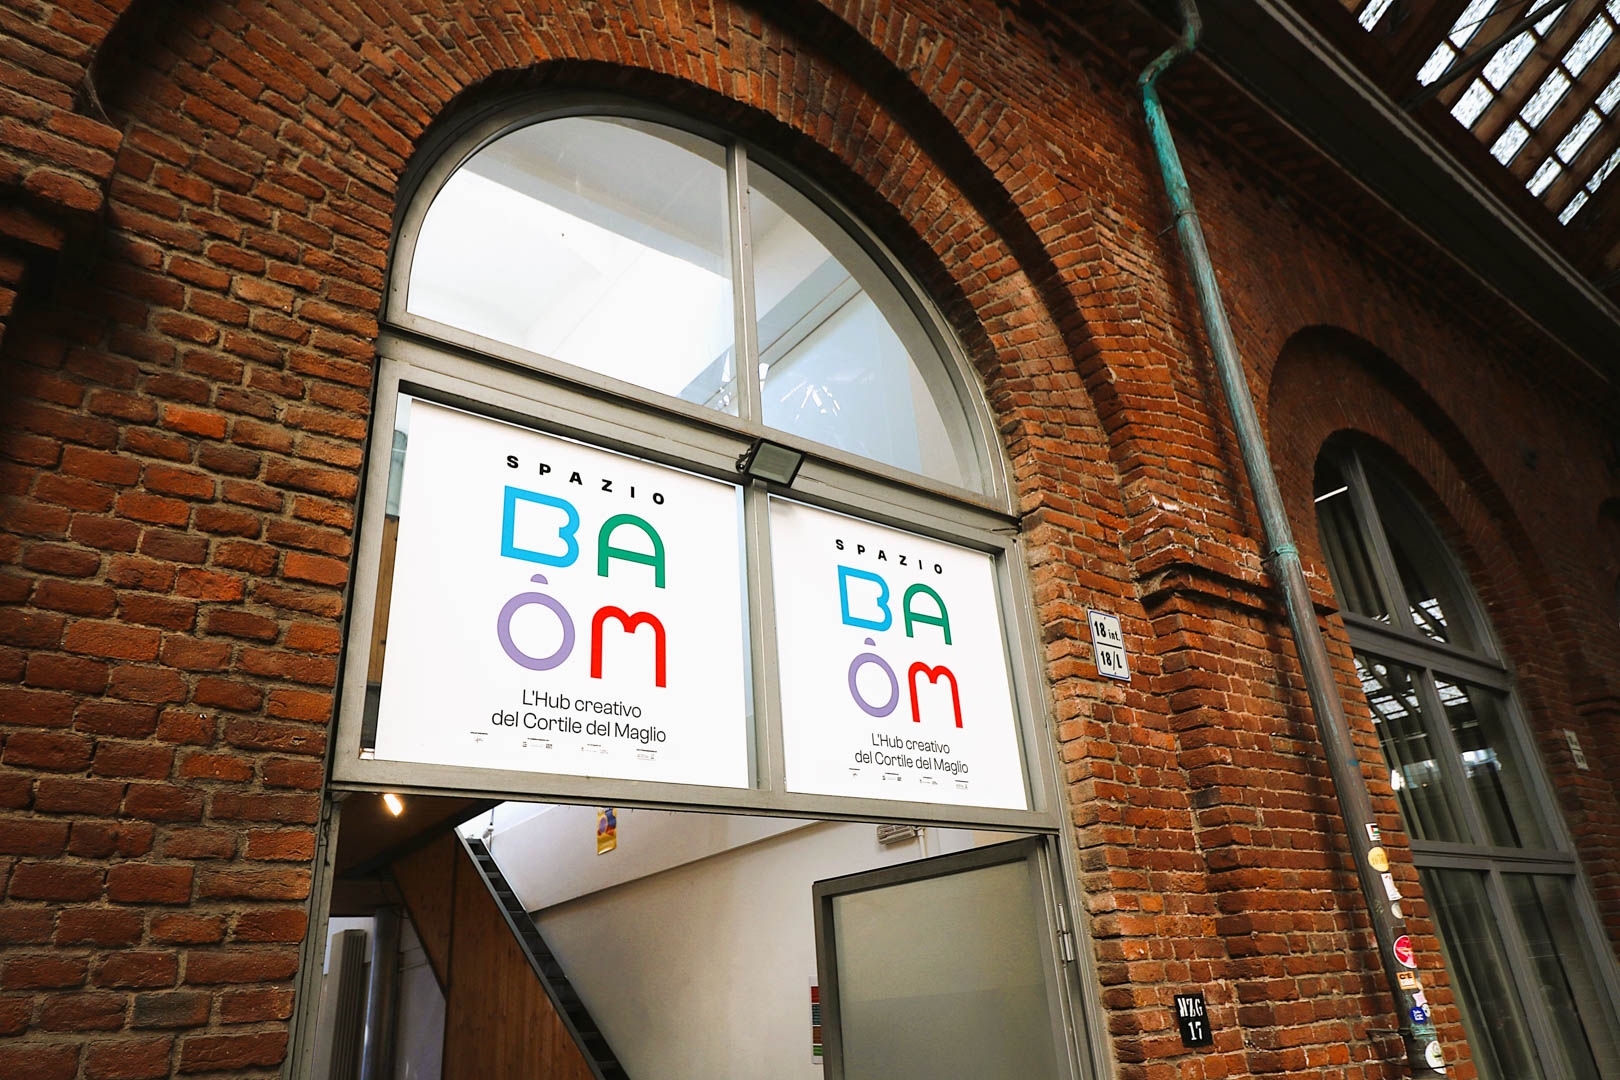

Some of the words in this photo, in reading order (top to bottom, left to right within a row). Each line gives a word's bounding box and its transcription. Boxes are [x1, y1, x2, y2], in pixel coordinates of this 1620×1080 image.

[506, 455, 665, 506] SPAZIO
[835, 538, 944, 575] SPAZIO
[1094, 620, 1107, 639] 18
[1108, 629, 1121, 642] int.
[1100, 650, 1123, 671] 18/L
[522, 688, 571, 710] L'Hub
[574, 699, 642, 719] creativo
[491, 709, 519, 728] del
[523, 712, 582, 734] Cortile
[585, 720, 611, 737] del
[614, 722, 667, 745] Maglio
[871, 732, 904, 749] L'Hub
[905, 739, 951, 755] creativo
[854, 750, 873, 764] del
[874, 751, 914, 768] Cortile
[915, 756, 932, 770] del
[933, 757, 969, 776] Maglio
[1187, 1021, 1203, 1041] 17
